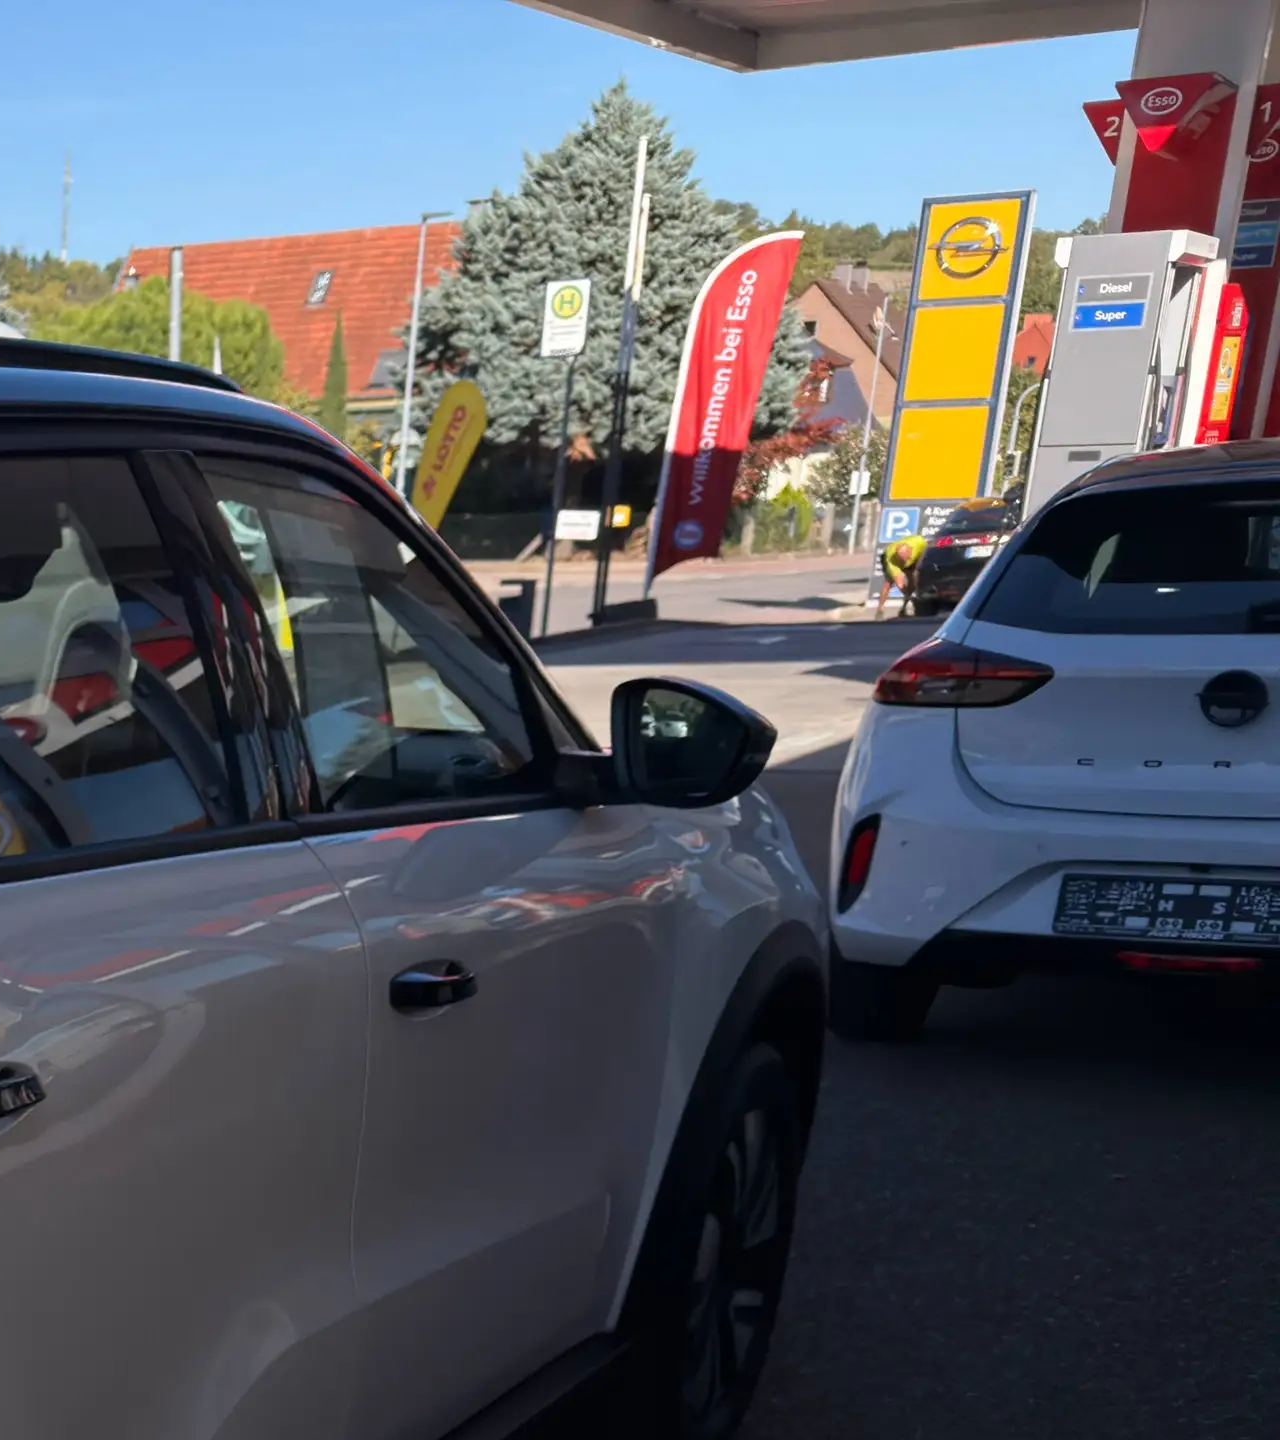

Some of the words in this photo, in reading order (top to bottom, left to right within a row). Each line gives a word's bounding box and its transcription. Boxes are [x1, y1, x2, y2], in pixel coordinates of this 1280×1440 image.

[1147, 95, 1177, 108] Esso
[1260, 101, 1272, 123] 1
[1103, 116, 1121, 137] 2
[726, 269, 758, 322] Esso
[1099, 281, 1133, 294] Diesel
[559, 292, 576, 312] H
[1094, 310, 1128, 322] Super
[714, 327, 744, 363] bei
[689, 367, 732, 505] willkommen
[886, 511, 909, 538] P
